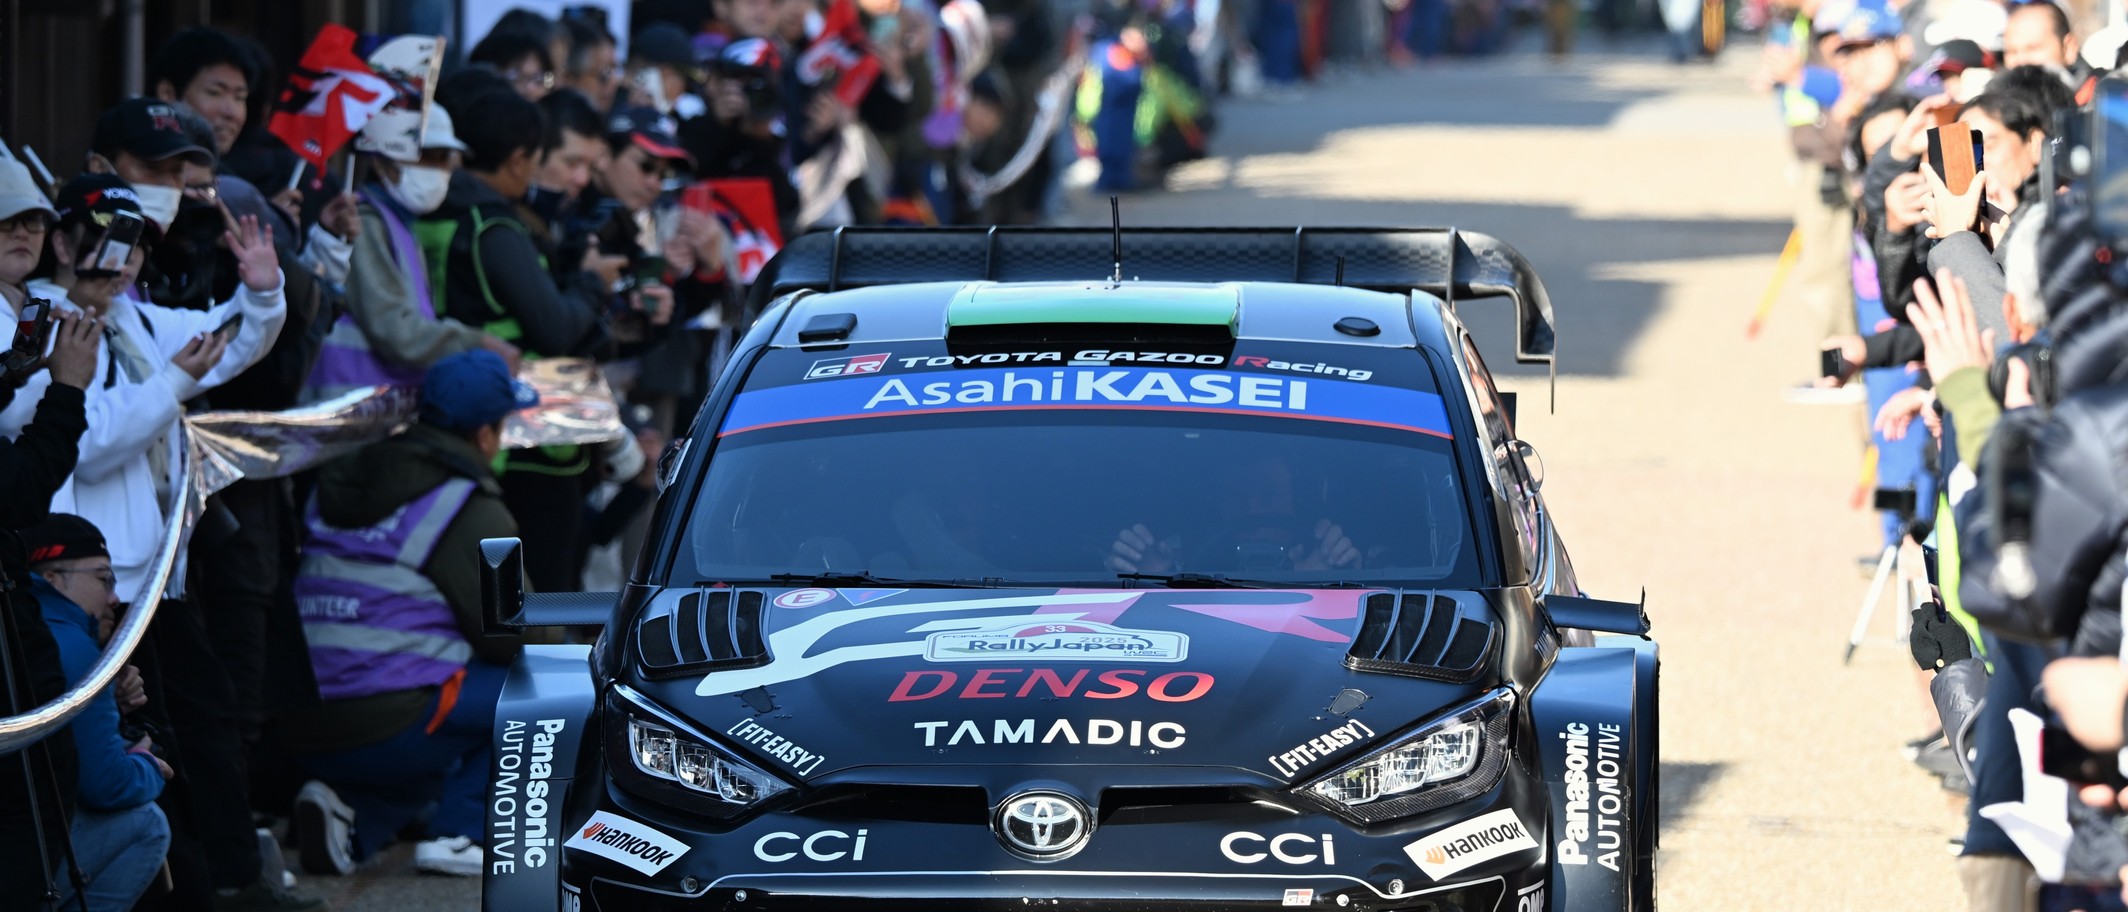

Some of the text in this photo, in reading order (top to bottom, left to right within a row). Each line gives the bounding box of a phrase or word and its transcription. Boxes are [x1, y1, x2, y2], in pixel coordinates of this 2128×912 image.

[809, 350, 1373, 381] GR TOYOTA GAZOO Racing
[299, 595, 360, 618] UNTEER
[1045, 625, 1066, 633] 33
[888, 669, 1215, 703] DENSO
[914, 718, 1186, 749] TAMADIC
[493, 720, 527, 875] AUTOMOTIVE
[524, 718, 566, 868] Panasonic
[1557, 722, 1590, 865] Panasonic
[1596, 723, 1621, 872] AUTOMOTIVE
[753, 829, 868, 863] CCi
[1220, 831, 1335, 865] CCi
